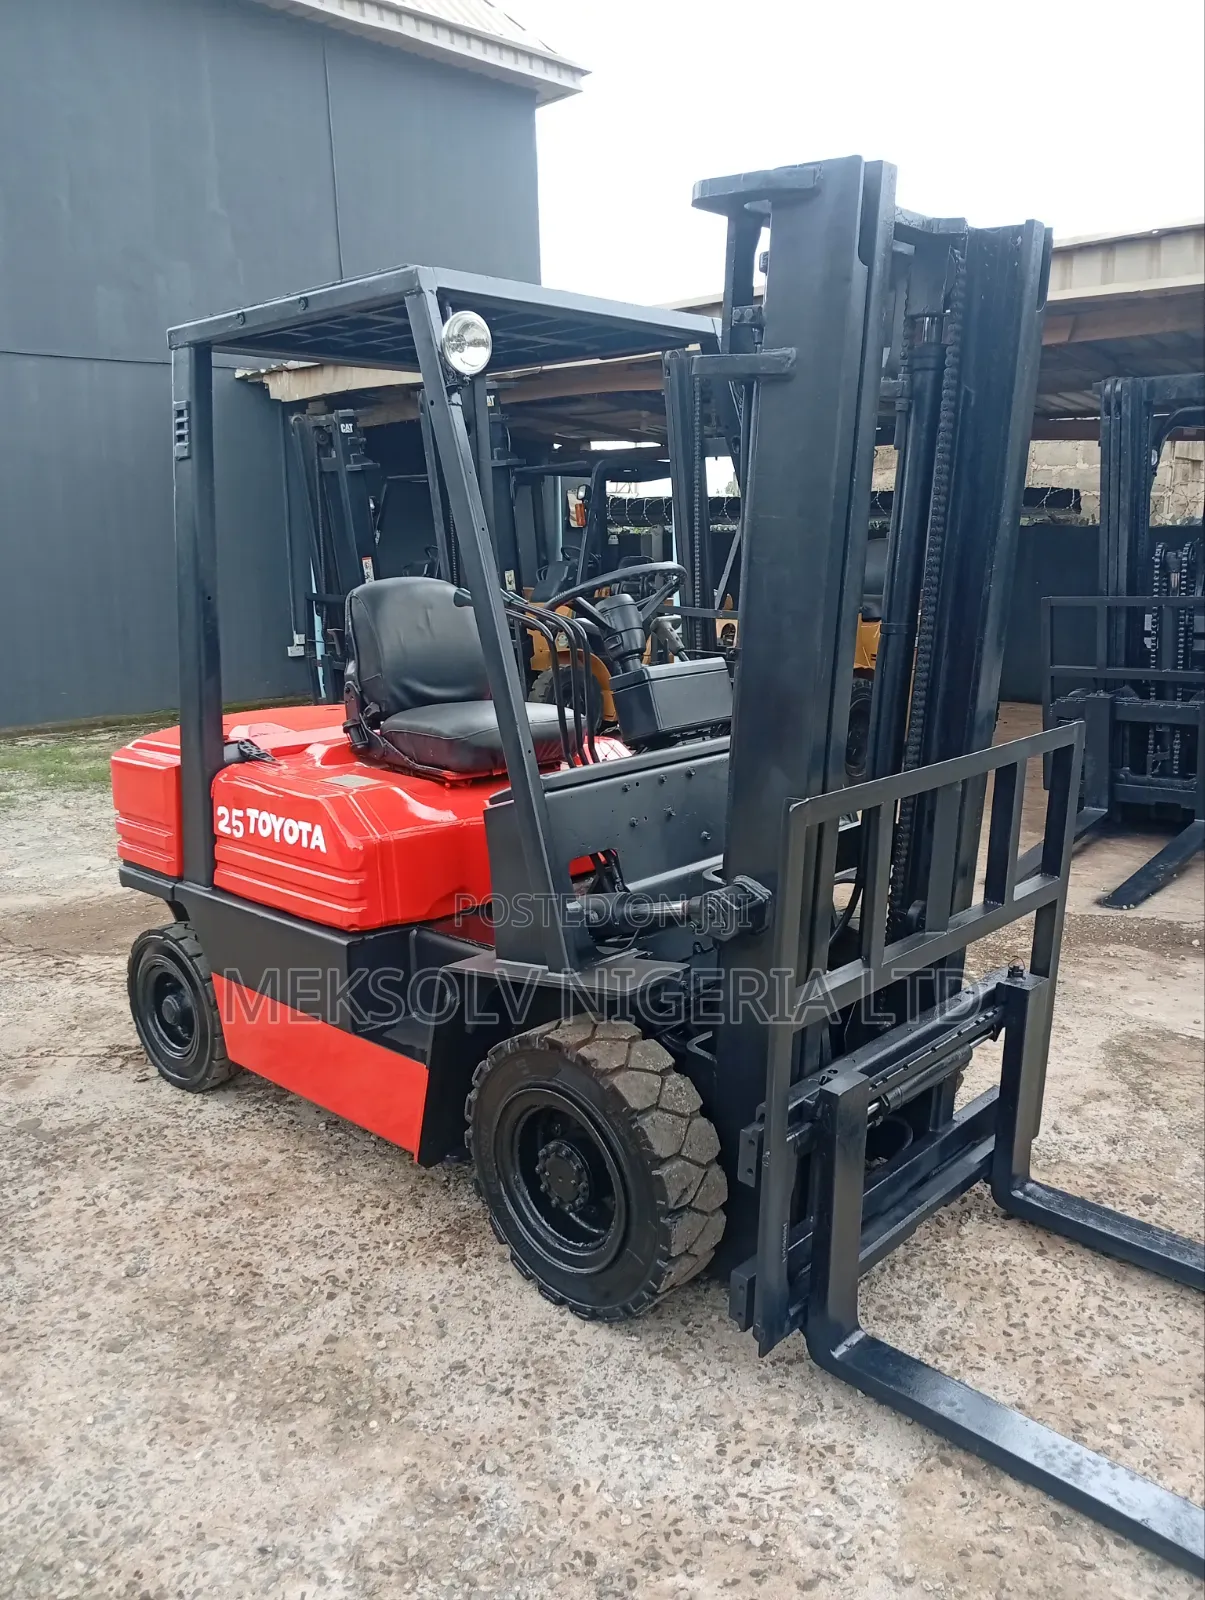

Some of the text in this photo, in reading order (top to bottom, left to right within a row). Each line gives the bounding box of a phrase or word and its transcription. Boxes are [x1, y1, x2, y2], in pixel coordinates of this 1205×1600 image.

[486, 395, 495, 406] AT
[340, 423, 353, 434] CAT
[217, 805, 327, 853] 25 TOYOTA
